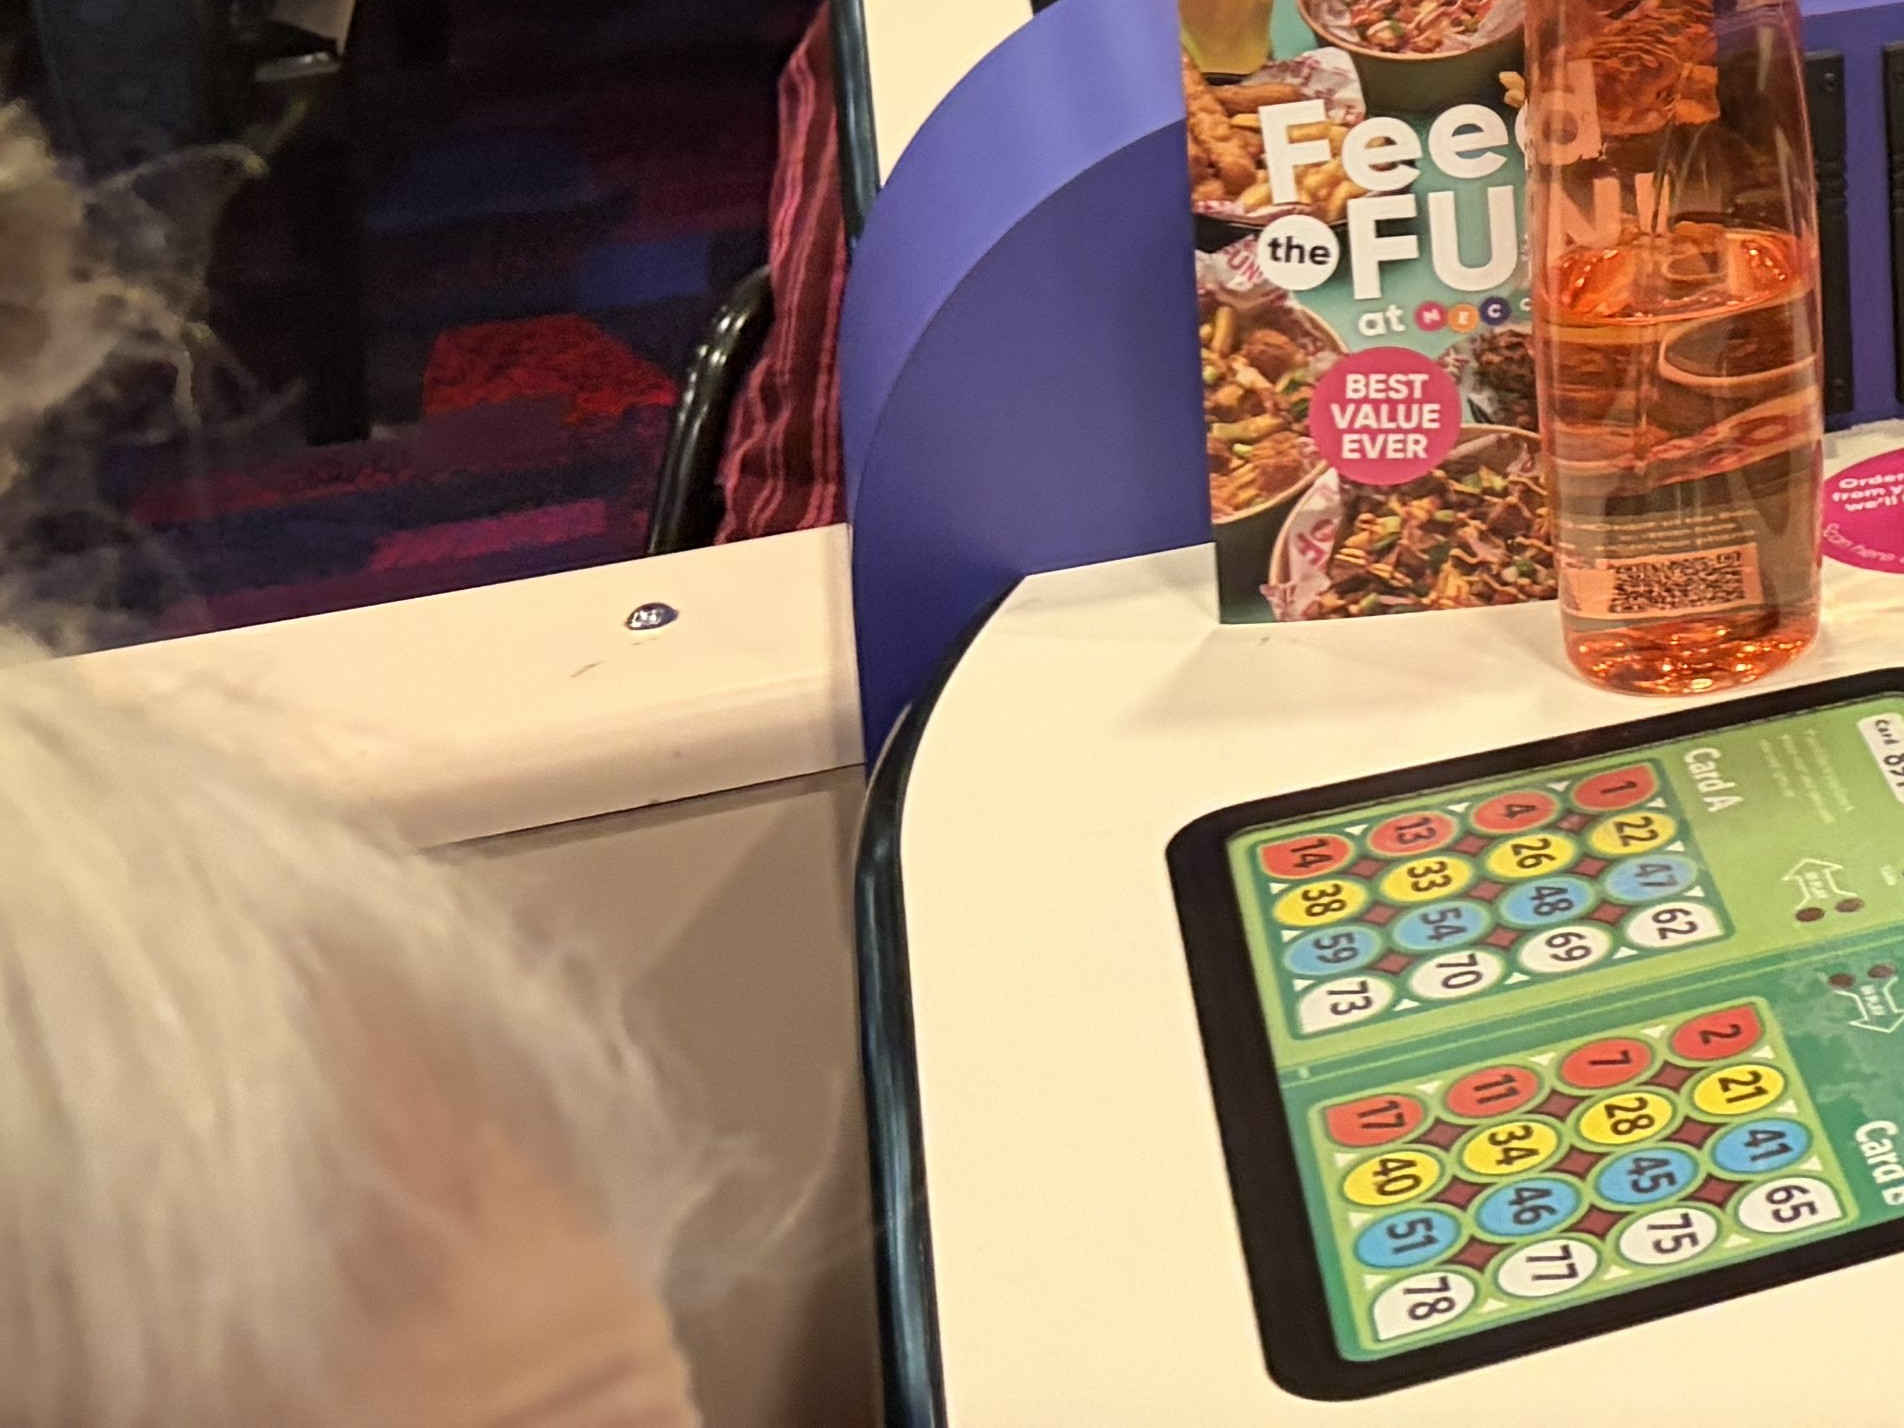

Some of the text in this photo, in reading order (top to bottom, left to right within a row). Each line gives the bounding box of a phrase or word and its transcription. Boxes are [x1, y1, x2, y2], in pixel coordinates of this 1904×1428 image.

[1258, 58, 1603, 204] Feed
[1268, 236, 1331, 266] the
[1358, 296, 1534, 336] at MECC
[1330, 403, 1441, 430] VALUE
[1341, 433, 1429, 460] EVER
[1345, 373, 1430, 400] BEST
[1831, 487, 1887, 502] from
[1685, 747, 1743, 812] Card A
[1875, 720, 1899, 745] Card
[1291, 839, 1372, 1015] 14 38 59 73
[1395, 817, 1483, 989] 13 33 54 70
[1504, 804, 1591, 961] 4 26 48 69
[1601, 781, 1697, 940] 1 22 47 62
[1474, 1074, 1578, 1280] 11 34 46 77
[1589, 1050, 1698, 1254] 7 28 45 75
[1700, 1024, 1817, 1223] 2 21 41 65
[1358, 1101, 1455, 1320] 17 40 51 78
